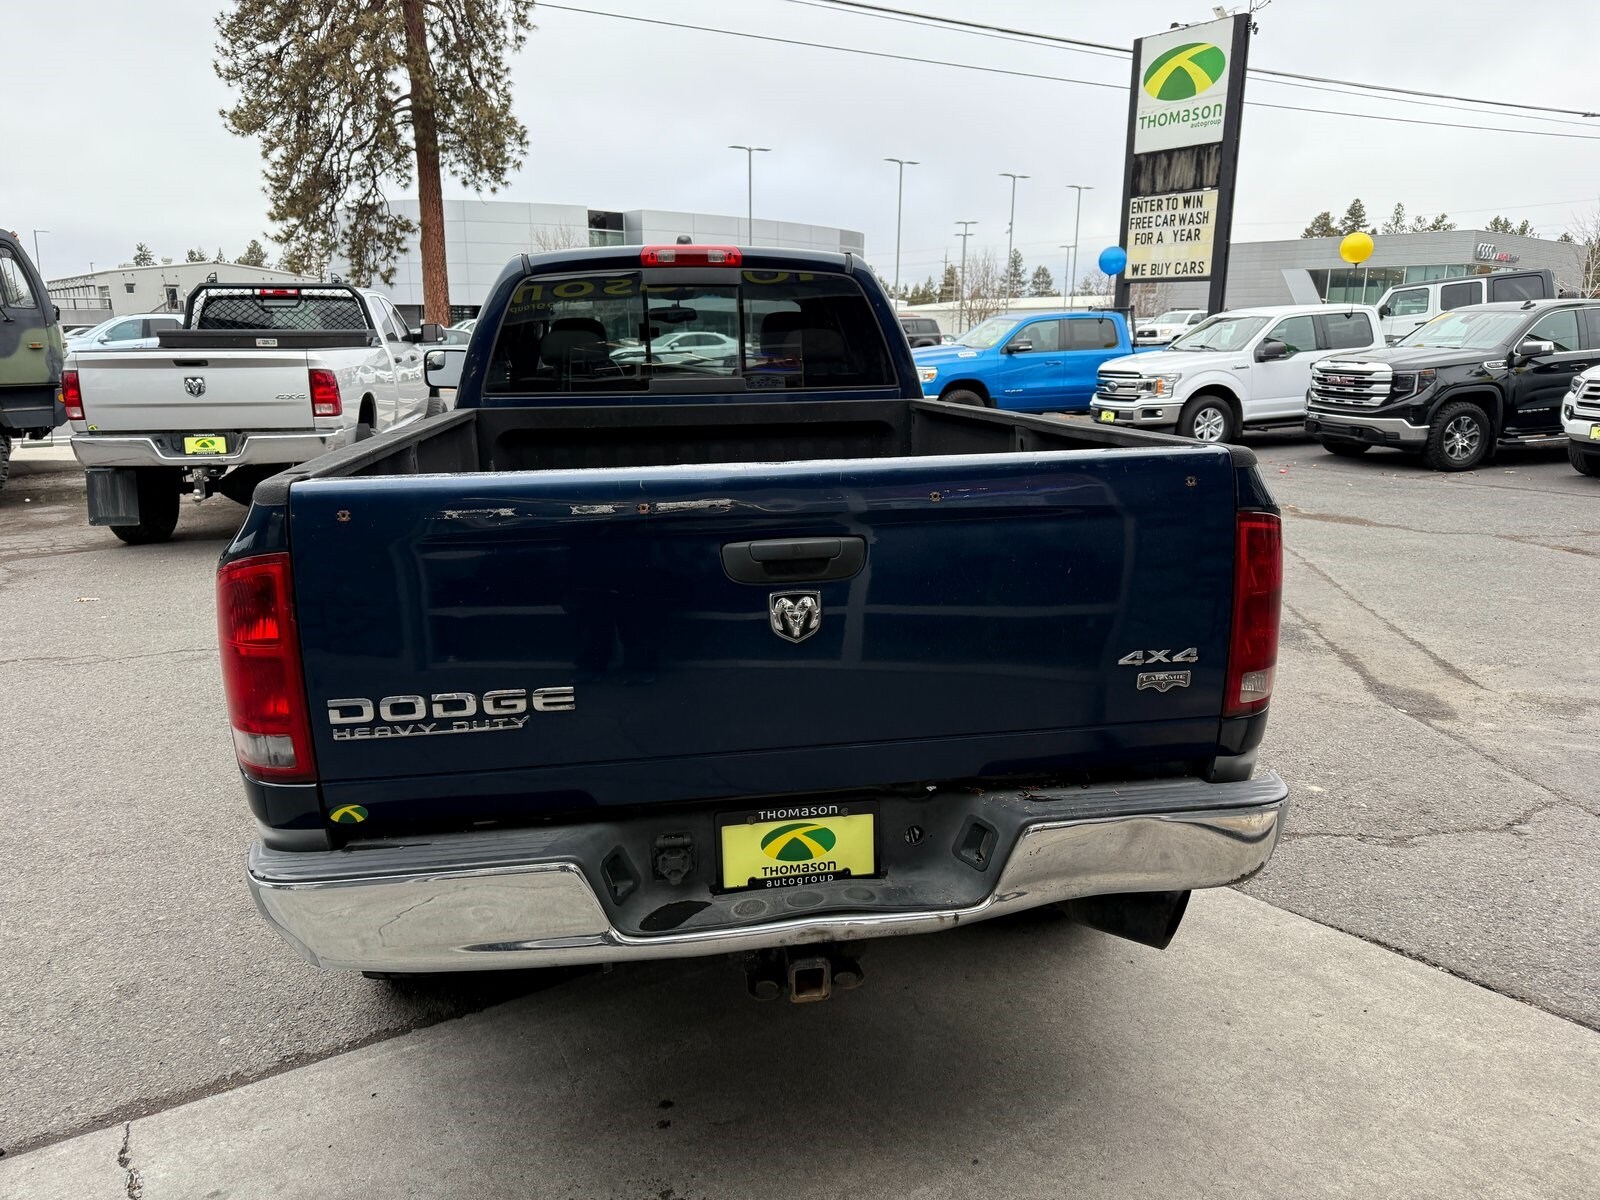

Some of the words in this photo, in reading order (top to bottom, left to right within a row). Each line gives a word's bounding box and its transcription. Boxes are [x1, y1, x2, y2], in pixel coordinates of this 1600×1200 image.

[1190, 118, 1222, 129] autogroup
[1131, 198, 1163, 214] ENTER
[1165, 196, 1178, 211] TO
[1182, 194, 1204, 209] WIN
[1129, 216, 1154, 230] FREE
[1154, 213, 1177, 227] CAR
[1178, 210, 1210, 226] WASH
[1134, 231, 1154, 245] FOR
[1156, 230, 1164, 243] A
[1172, 227, 1201, 242] YEAR
[1131, 263, 1147, 276] WE
[1150, 262, 1172, 275] BUY
[1174, 260, 1205, 275] CARS
[327, 686, 576, 725] DODGE
[333, 723, 437, 741] HEAVY
[452, 714, 531, 734] DUTY
[766, 873, 834, 888] autogroup
